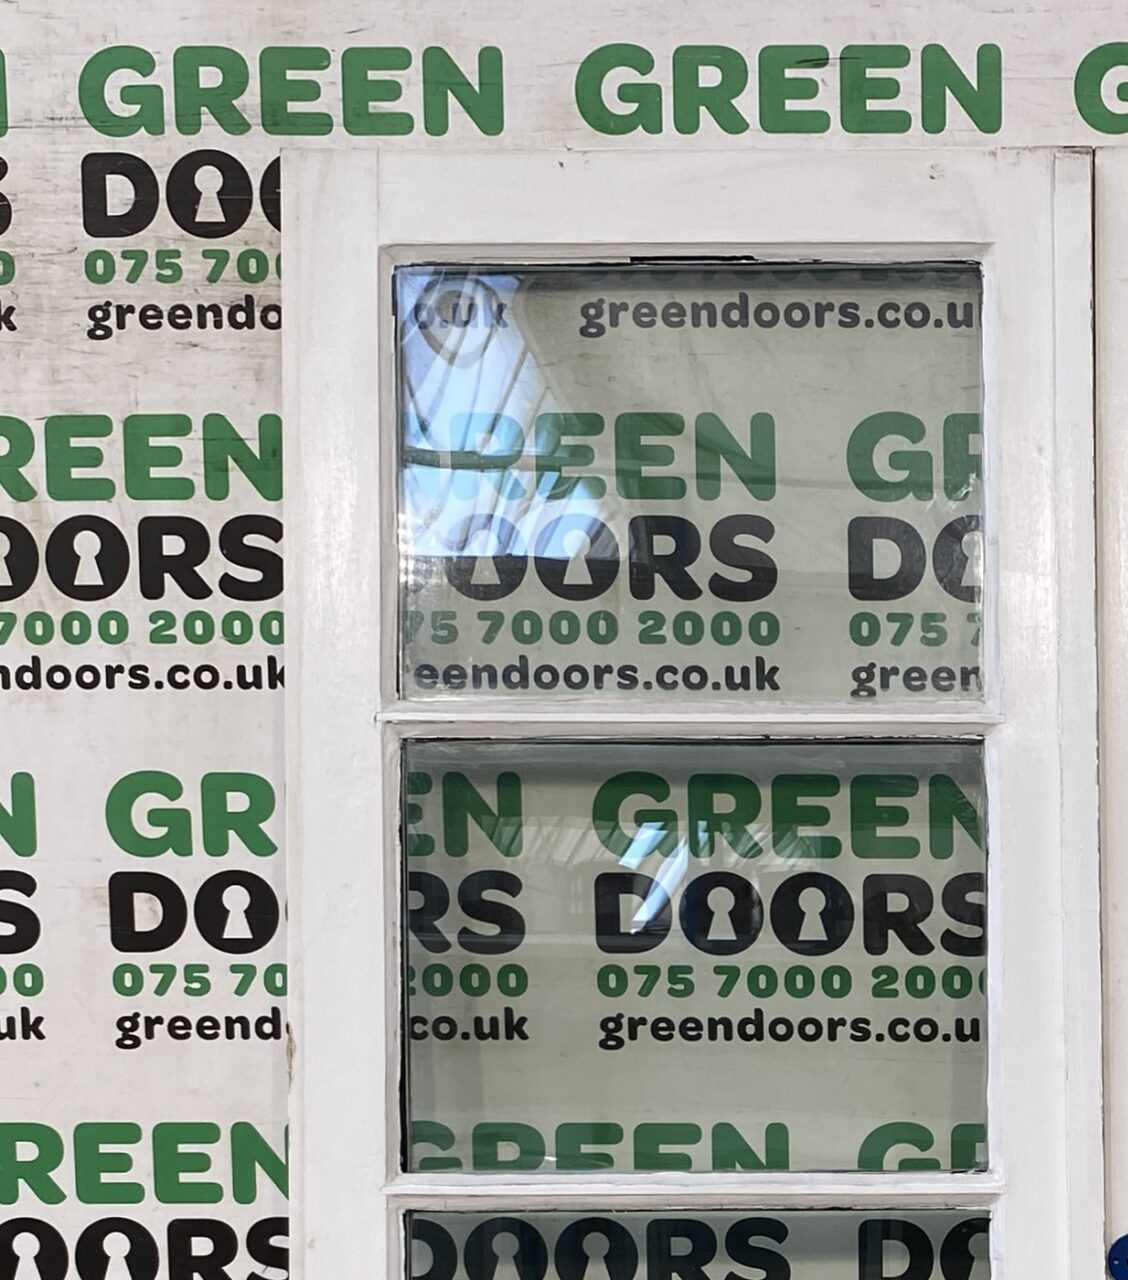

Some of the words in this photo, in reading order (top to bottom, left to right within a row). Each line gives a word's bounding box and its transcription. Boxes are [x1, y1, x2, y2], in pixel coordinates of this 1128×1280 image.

[78, 45, 504, 136] GREEN
[574, 43, 1002, 134] GREEN
[85, 249, 184, 285] 075
[201, 249, 282, 284] 70
[579, 294, 982, 338] greendoors.co.u
[447, 514, 778, 602] OORS
[149, 611, 284, 645] 2000
[478, 610, 619, 645] 7000
[638, 610, 780, 645] 2000
[850, 611, 948, 646] 075
[414, 656, 780, 692] eendoors.co.uk
[112, 964, 210, 998] 075
[229, 964, 288, 998] 70
[408, 964, 529, 998] 000
[598, 965, 695, 998] 075
[712, 965, 851, 999] 7000
[871, 965, 985, 999] 200
[599, 1009, 980, 1050] greendoors.co.u
[0, 1122, 289, 1205] REEN
